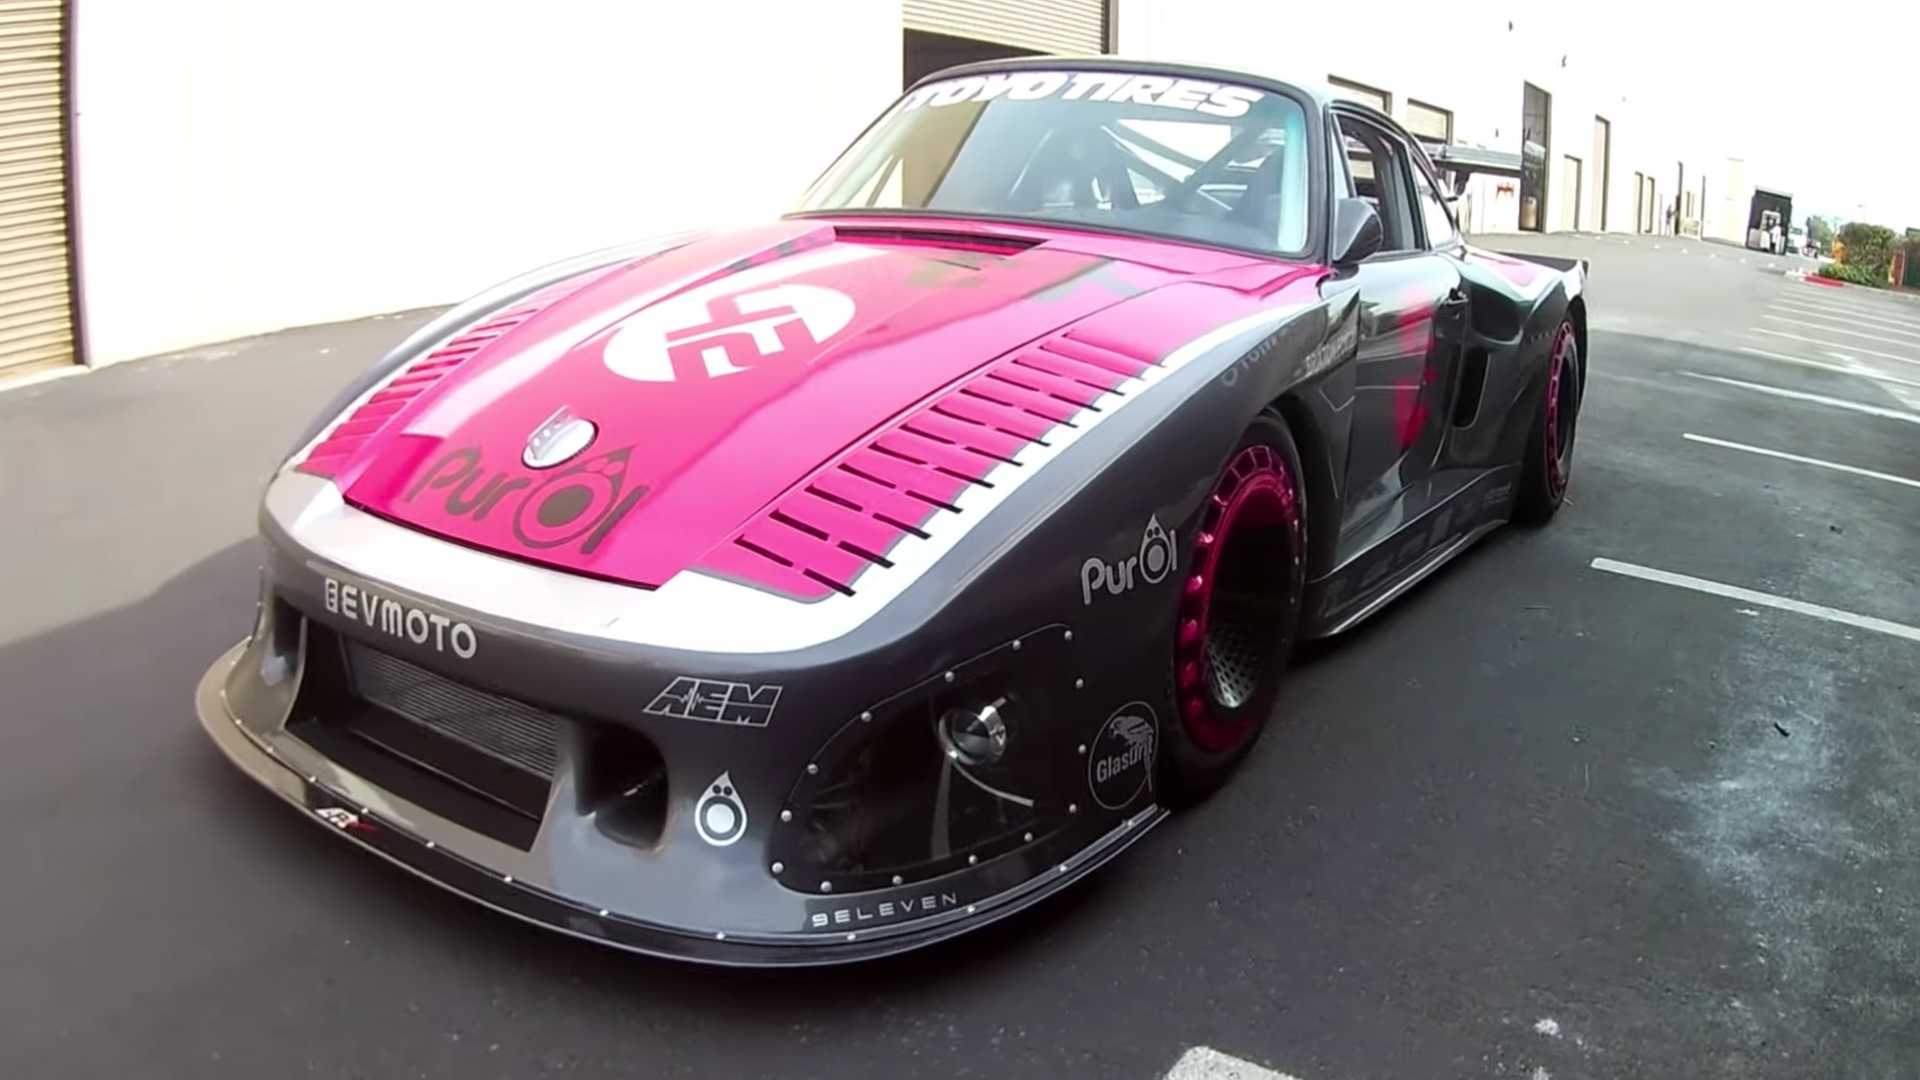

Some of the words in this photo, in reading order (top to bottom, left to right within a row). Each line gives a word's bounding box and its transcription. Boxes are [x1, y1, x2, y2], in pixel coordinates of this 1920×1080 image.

[904, 72, 1060, 111] TOYO
[1058, 73, 1265, 118] TIRES
[643, 676, 783, 727] AEM
